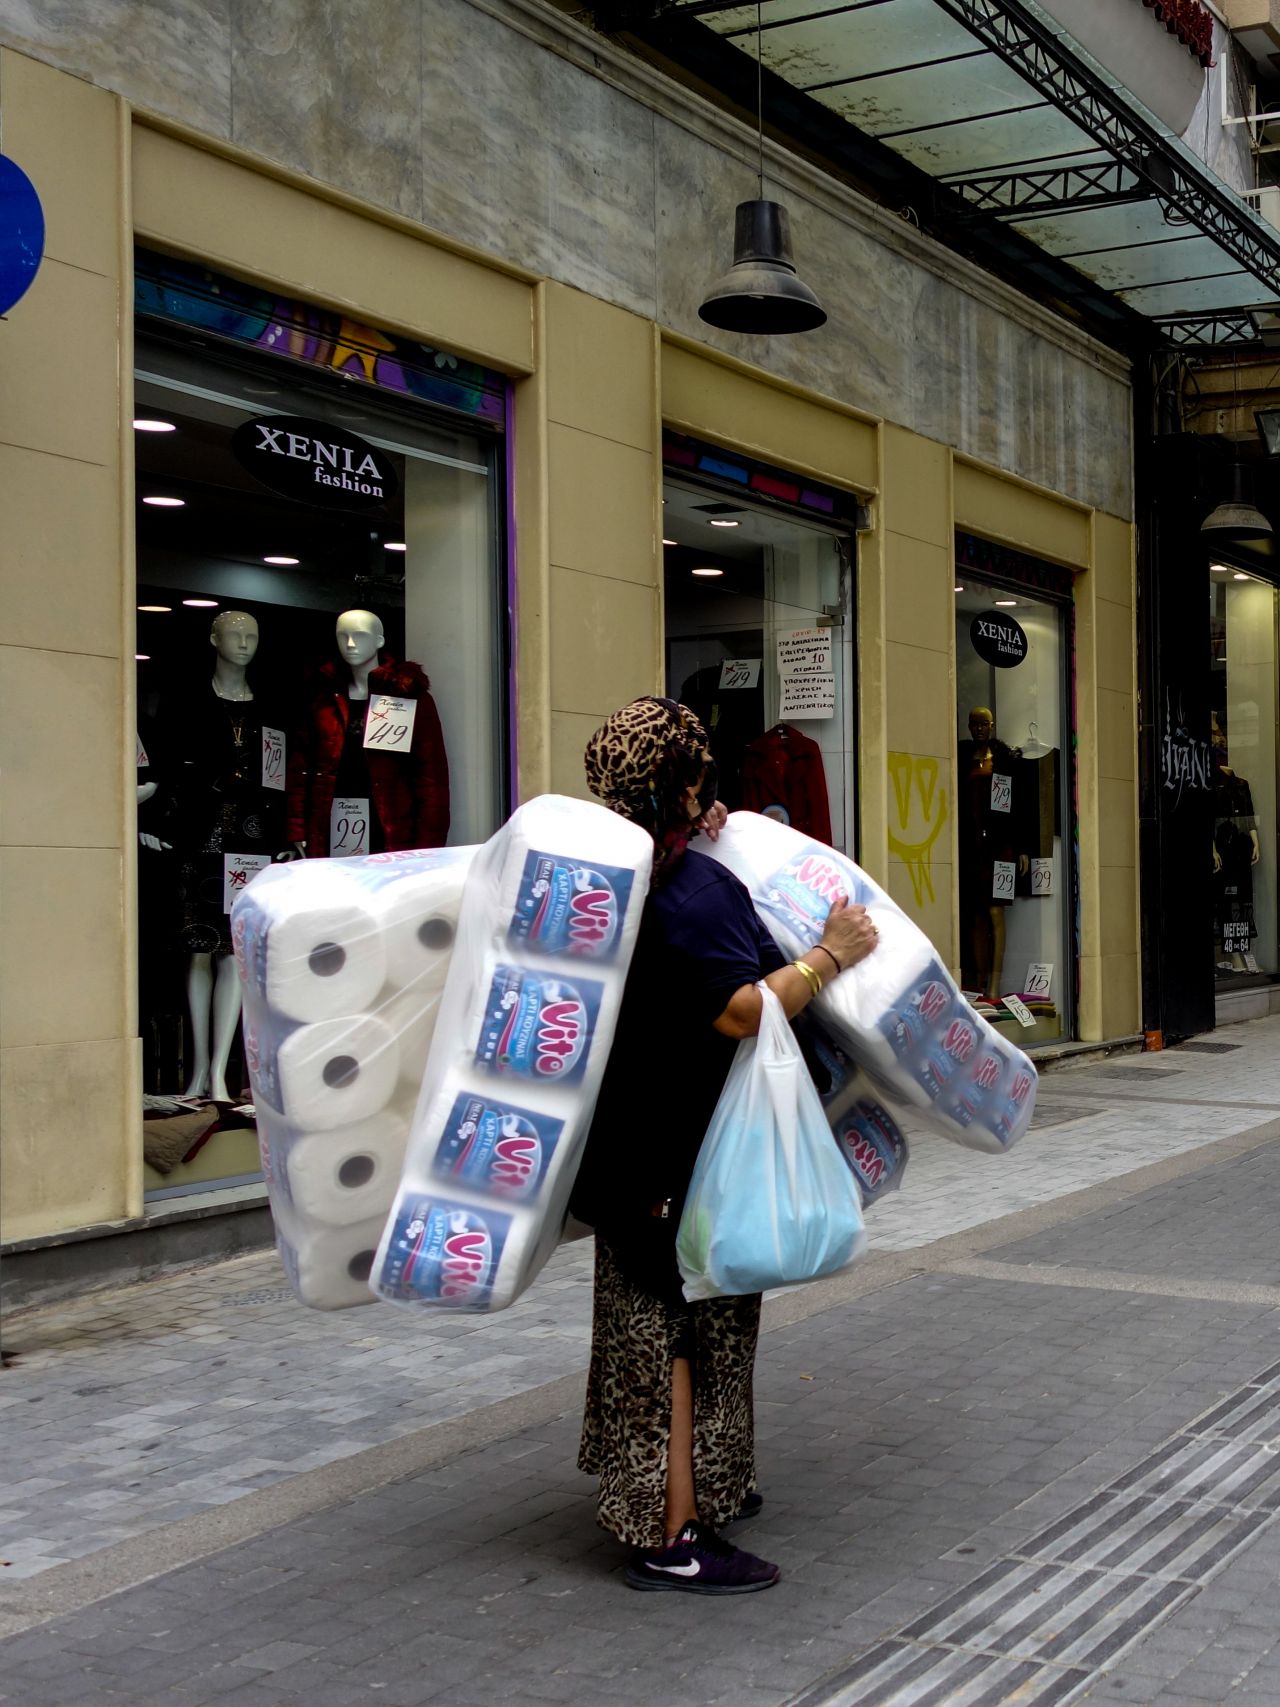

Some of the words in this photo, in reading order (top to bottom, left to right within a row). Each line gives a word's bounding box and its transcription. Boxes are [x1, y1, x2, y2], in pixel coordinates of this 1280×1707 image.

[255, 424, 383, 480] XENIA
[313, 466, 384, 498] fashion
[977, 620, 1023, 646] XENIA
[811, 653, 825, 664] 10
[997, 641, 1023, 656] fashion
[367, 722, 408, 745] 49
[334, 818, 366, 850] 29
[557, 873, 570, 903] ΧΑΡΤΙ
[997, 873, 1013, 892] 29
[1035, 870, 1051, 889] 29
[1223, 922, 1249, 938] ΜΕΓΕΘΗ
[1224, 939, 1233, 952] 48
[1240, 938, 1249, 952] 64
[1027, 974, 1049, 993] 15
[1014, 1004, 1031, 1023] 15
[536, 1001, 580, 1075] Vito
[482, 1117, 495, 1147] ΧΑΡΤΙ
[845, 1129, 886, 1188] Vito
